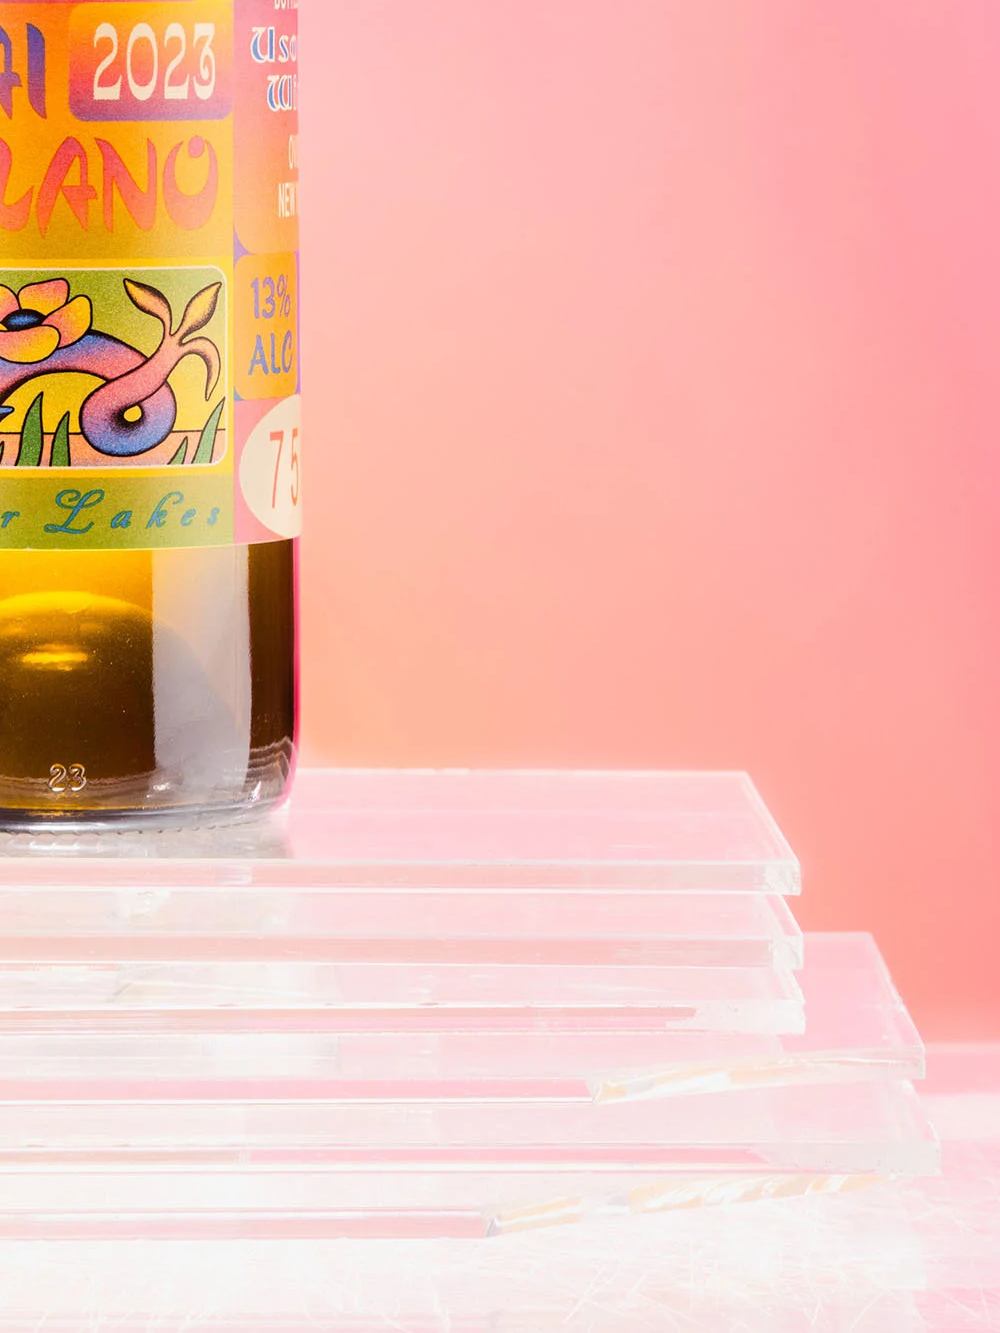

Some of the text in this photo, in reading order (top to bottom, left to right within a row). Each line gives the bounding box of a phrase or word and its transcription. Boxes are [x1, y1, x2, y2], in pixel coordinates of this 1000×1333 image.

[92, 22, 216, 101] 2023
[250, 274, 291, 319] 13%
[248, 330, 293, 376] ALC
[269, 428, 298, 509] 75
[44, 489, 220, 535] Lakes
[48, 762, 88, 792] 23
